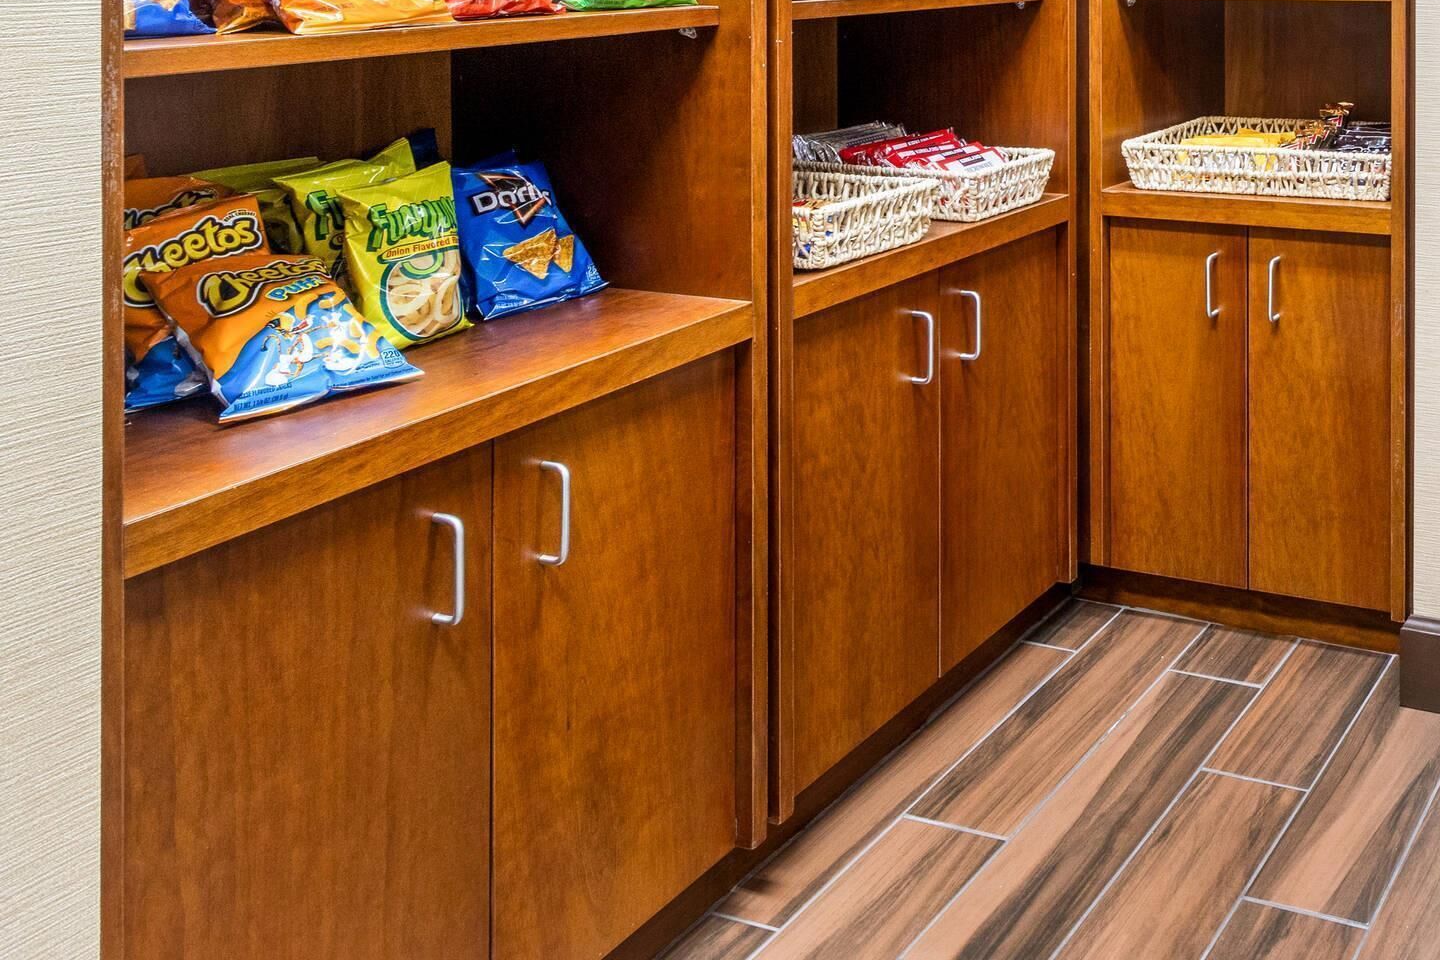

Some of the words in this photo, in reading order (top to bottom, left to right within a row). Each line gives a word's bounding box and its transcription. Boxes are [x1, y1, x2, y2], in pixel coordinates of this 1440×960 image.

[123, 218, 258, 306] Cheetos
[386, 246, 410, 259] Onion
[413, 237, 451, 252] Flavored
[201, 260, 330, 315] Cheetos
[383, 349, 401, 360] 220
